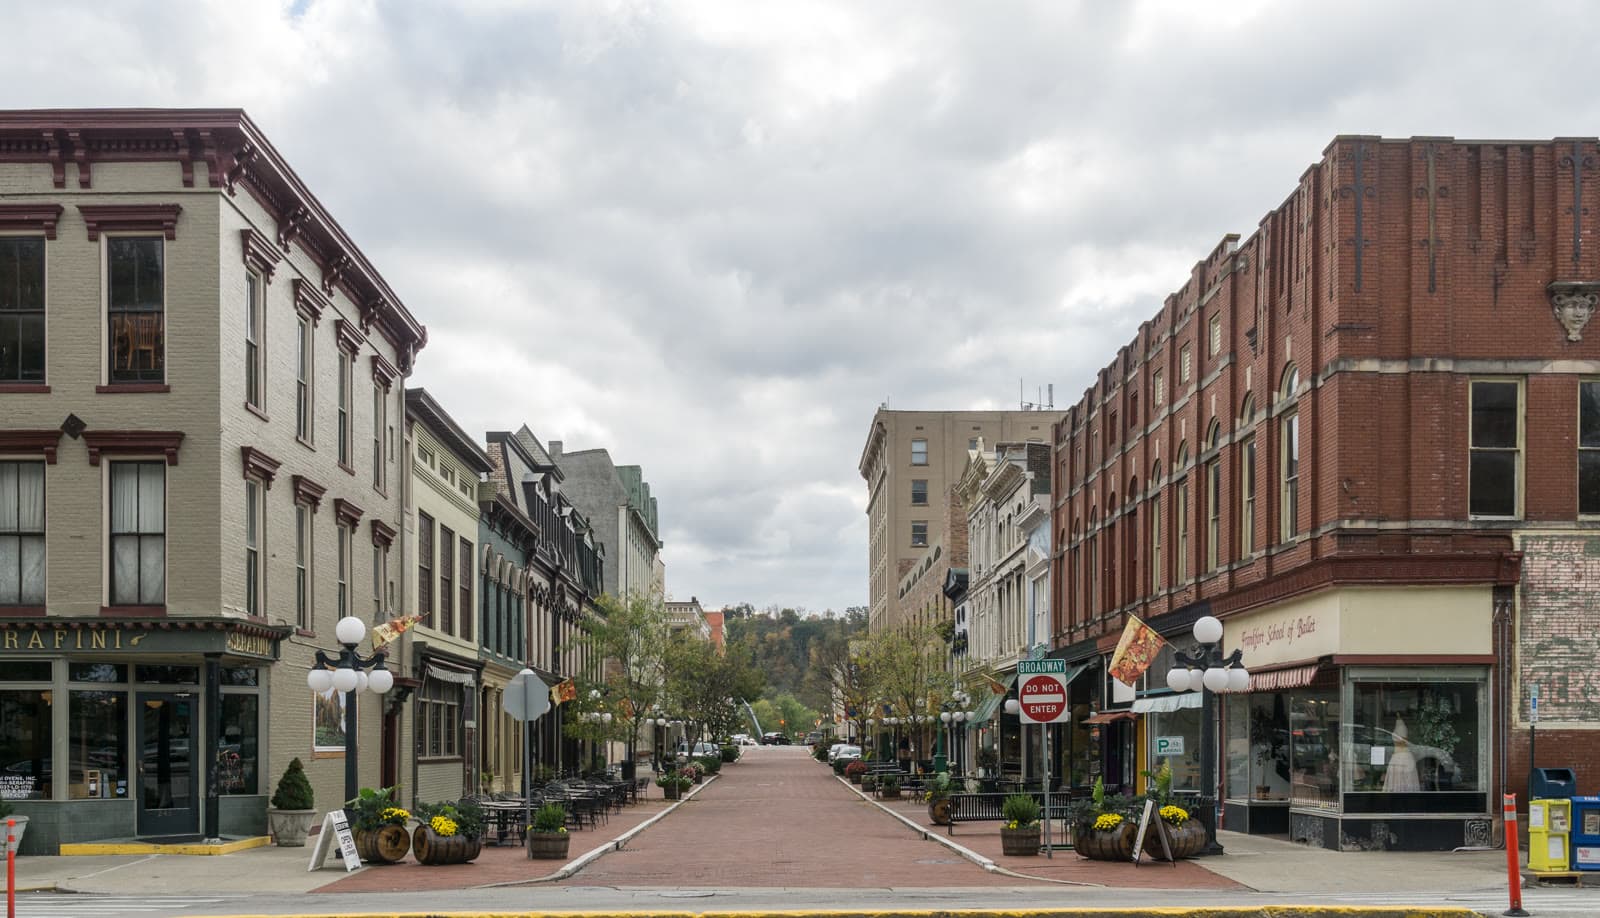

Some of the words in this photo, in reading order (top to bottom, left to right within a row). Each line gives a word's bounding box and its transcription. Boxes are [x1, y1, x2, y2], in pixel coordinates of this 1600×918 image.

[1525, 540, 1549, 553] THE
[1551, 540, 1587, 553] BEST
[4, 629, 122, 649] RAFINI
[1241, 628, 1265, 651] Frankfort
[1266, 621, 1286, 645] School
[1287, 619, 1296, 645] of
[1297, 615, 1316, 638] Ballet
[1019, 661, 1064, 673] BROADWAY
[1026, 685, 1038, 693] DO
[1042, 684, 1059, 692] NOT
[1030, 705, 1057, 714] ENTER
